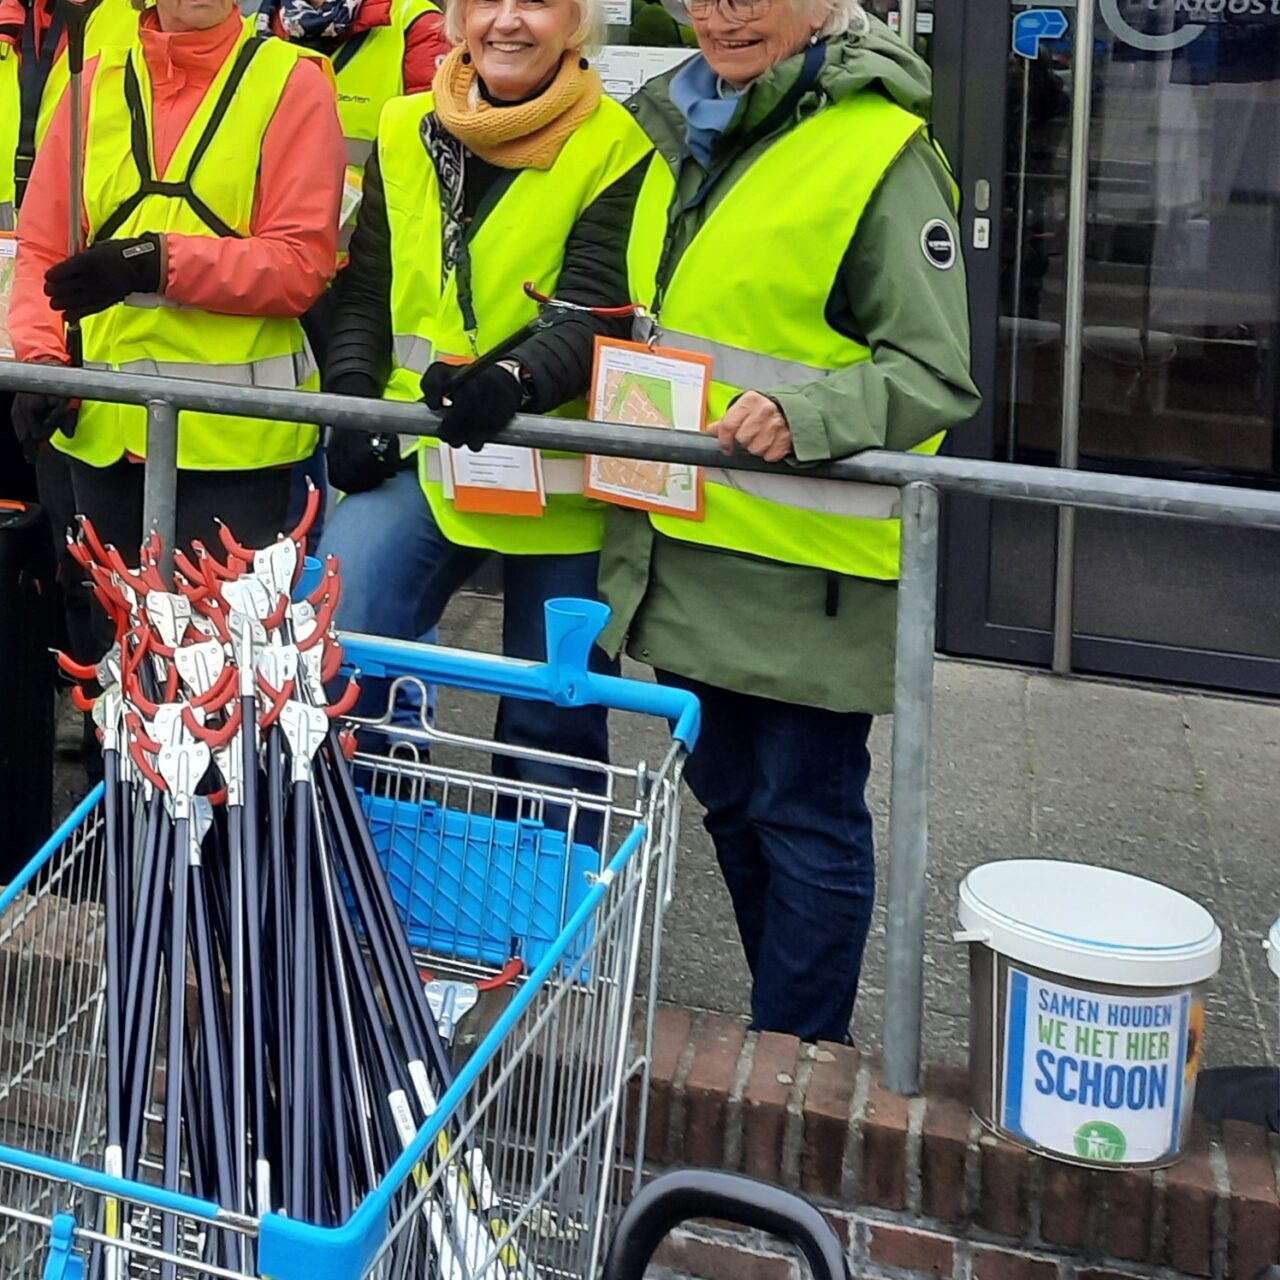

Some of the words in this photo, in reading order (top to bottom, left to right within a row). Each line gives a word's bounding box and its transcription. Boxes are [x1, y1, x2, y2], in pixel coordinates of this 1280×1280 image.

[1038, 988, 1099, 1025] SAMEN
[1108, 1003, 1173, 1028] HOUDEN
[1038, 1014, 1068, 1050] WE
[1075, 1025, 1119, 1059] HET
[1126, 1030, 1170, 1061] HIER
[1034, 1048, 1169, 1111] SCHOON
